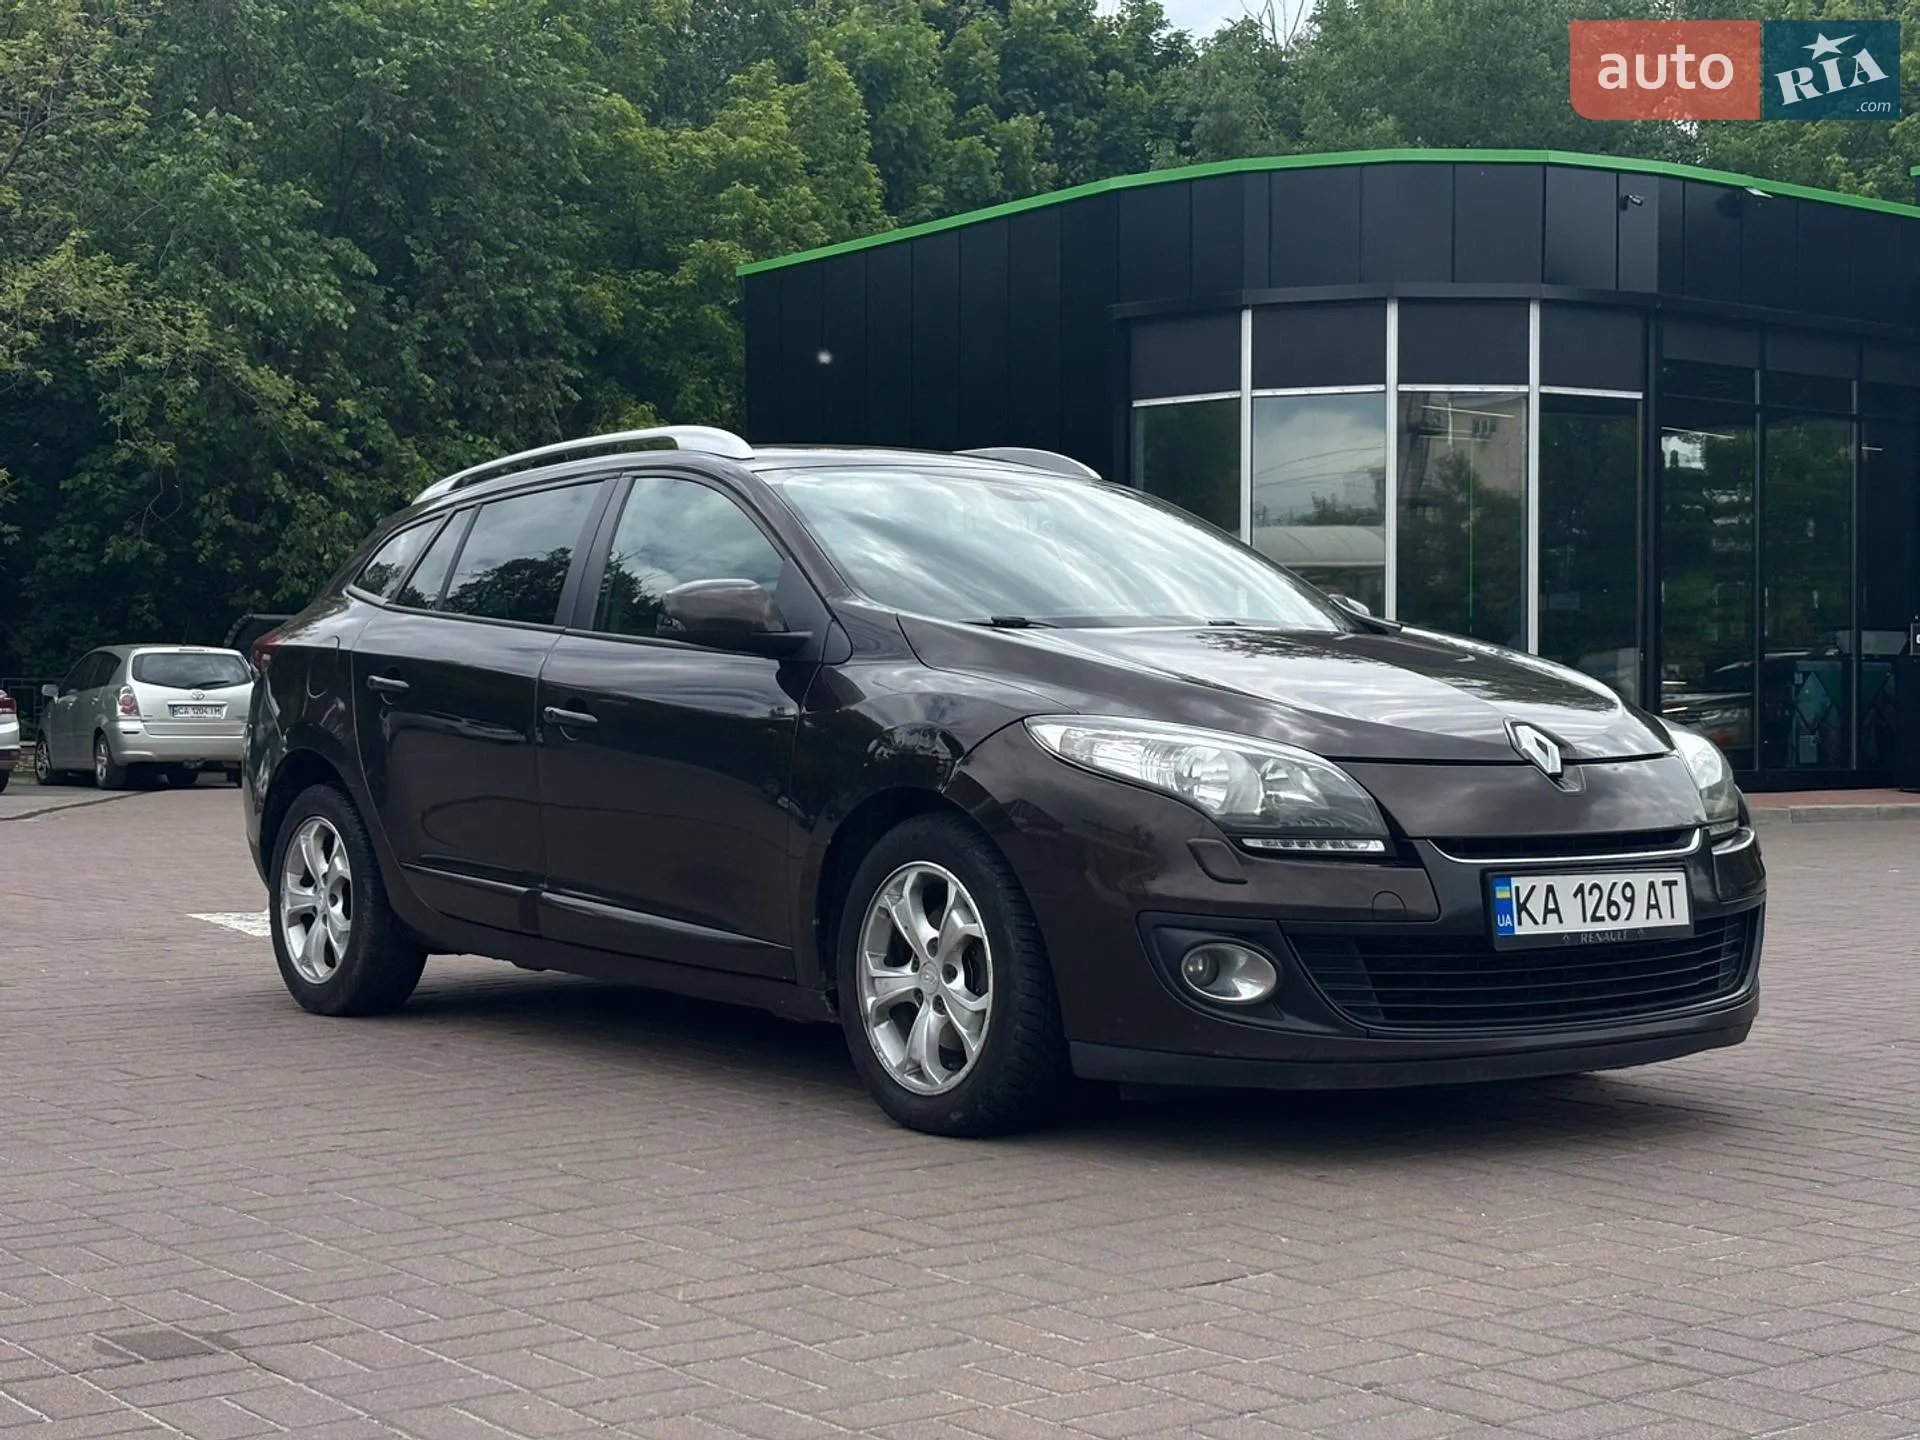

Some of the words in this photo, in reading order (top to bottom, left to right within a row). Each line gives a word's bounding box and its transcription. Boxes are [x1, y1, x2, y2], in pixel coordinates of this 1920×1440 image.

[1514, 884, 1564, 926] KA
[1572, 881, 1636, 923] 1269
[1646, 879, 1678, 920] AT
[1497, 914, 1513, 927] UA
[1580, 930, 1627, 944] RENAULT
